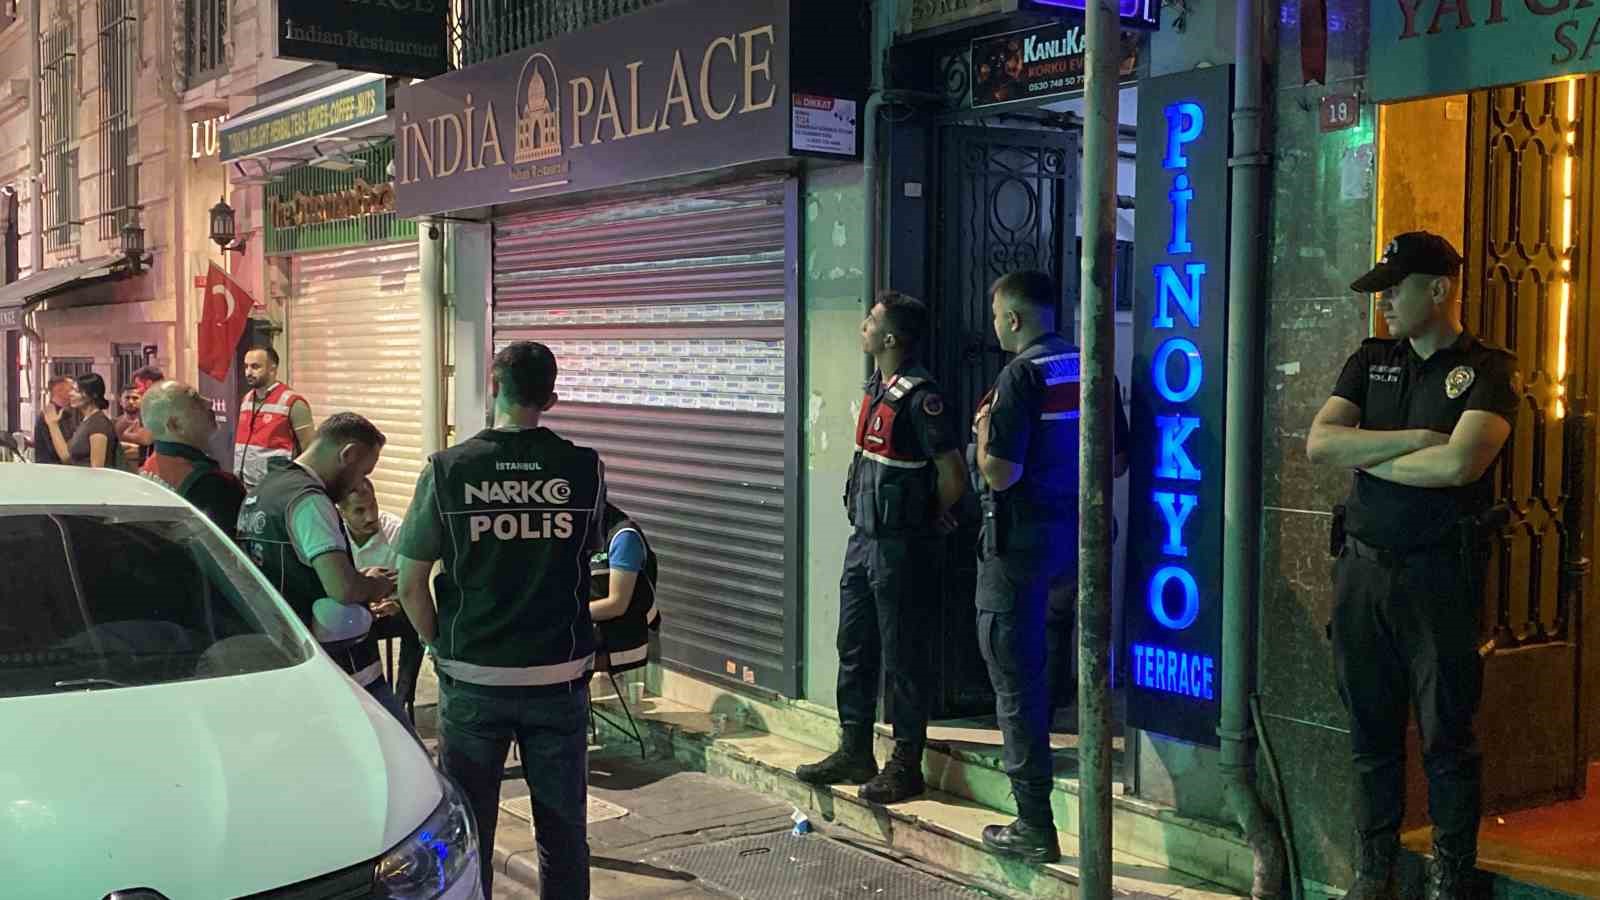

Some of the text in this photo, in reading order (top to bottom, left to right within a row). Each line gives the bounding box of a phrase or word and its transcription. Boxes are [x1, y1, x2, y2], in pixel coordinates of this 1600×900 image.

[400, 24, 777, 185] İNDİA PALACE
[1150, 101, 1207, 632] PİNOKYO
[1134, 645, 1213, 700] TERRACE
